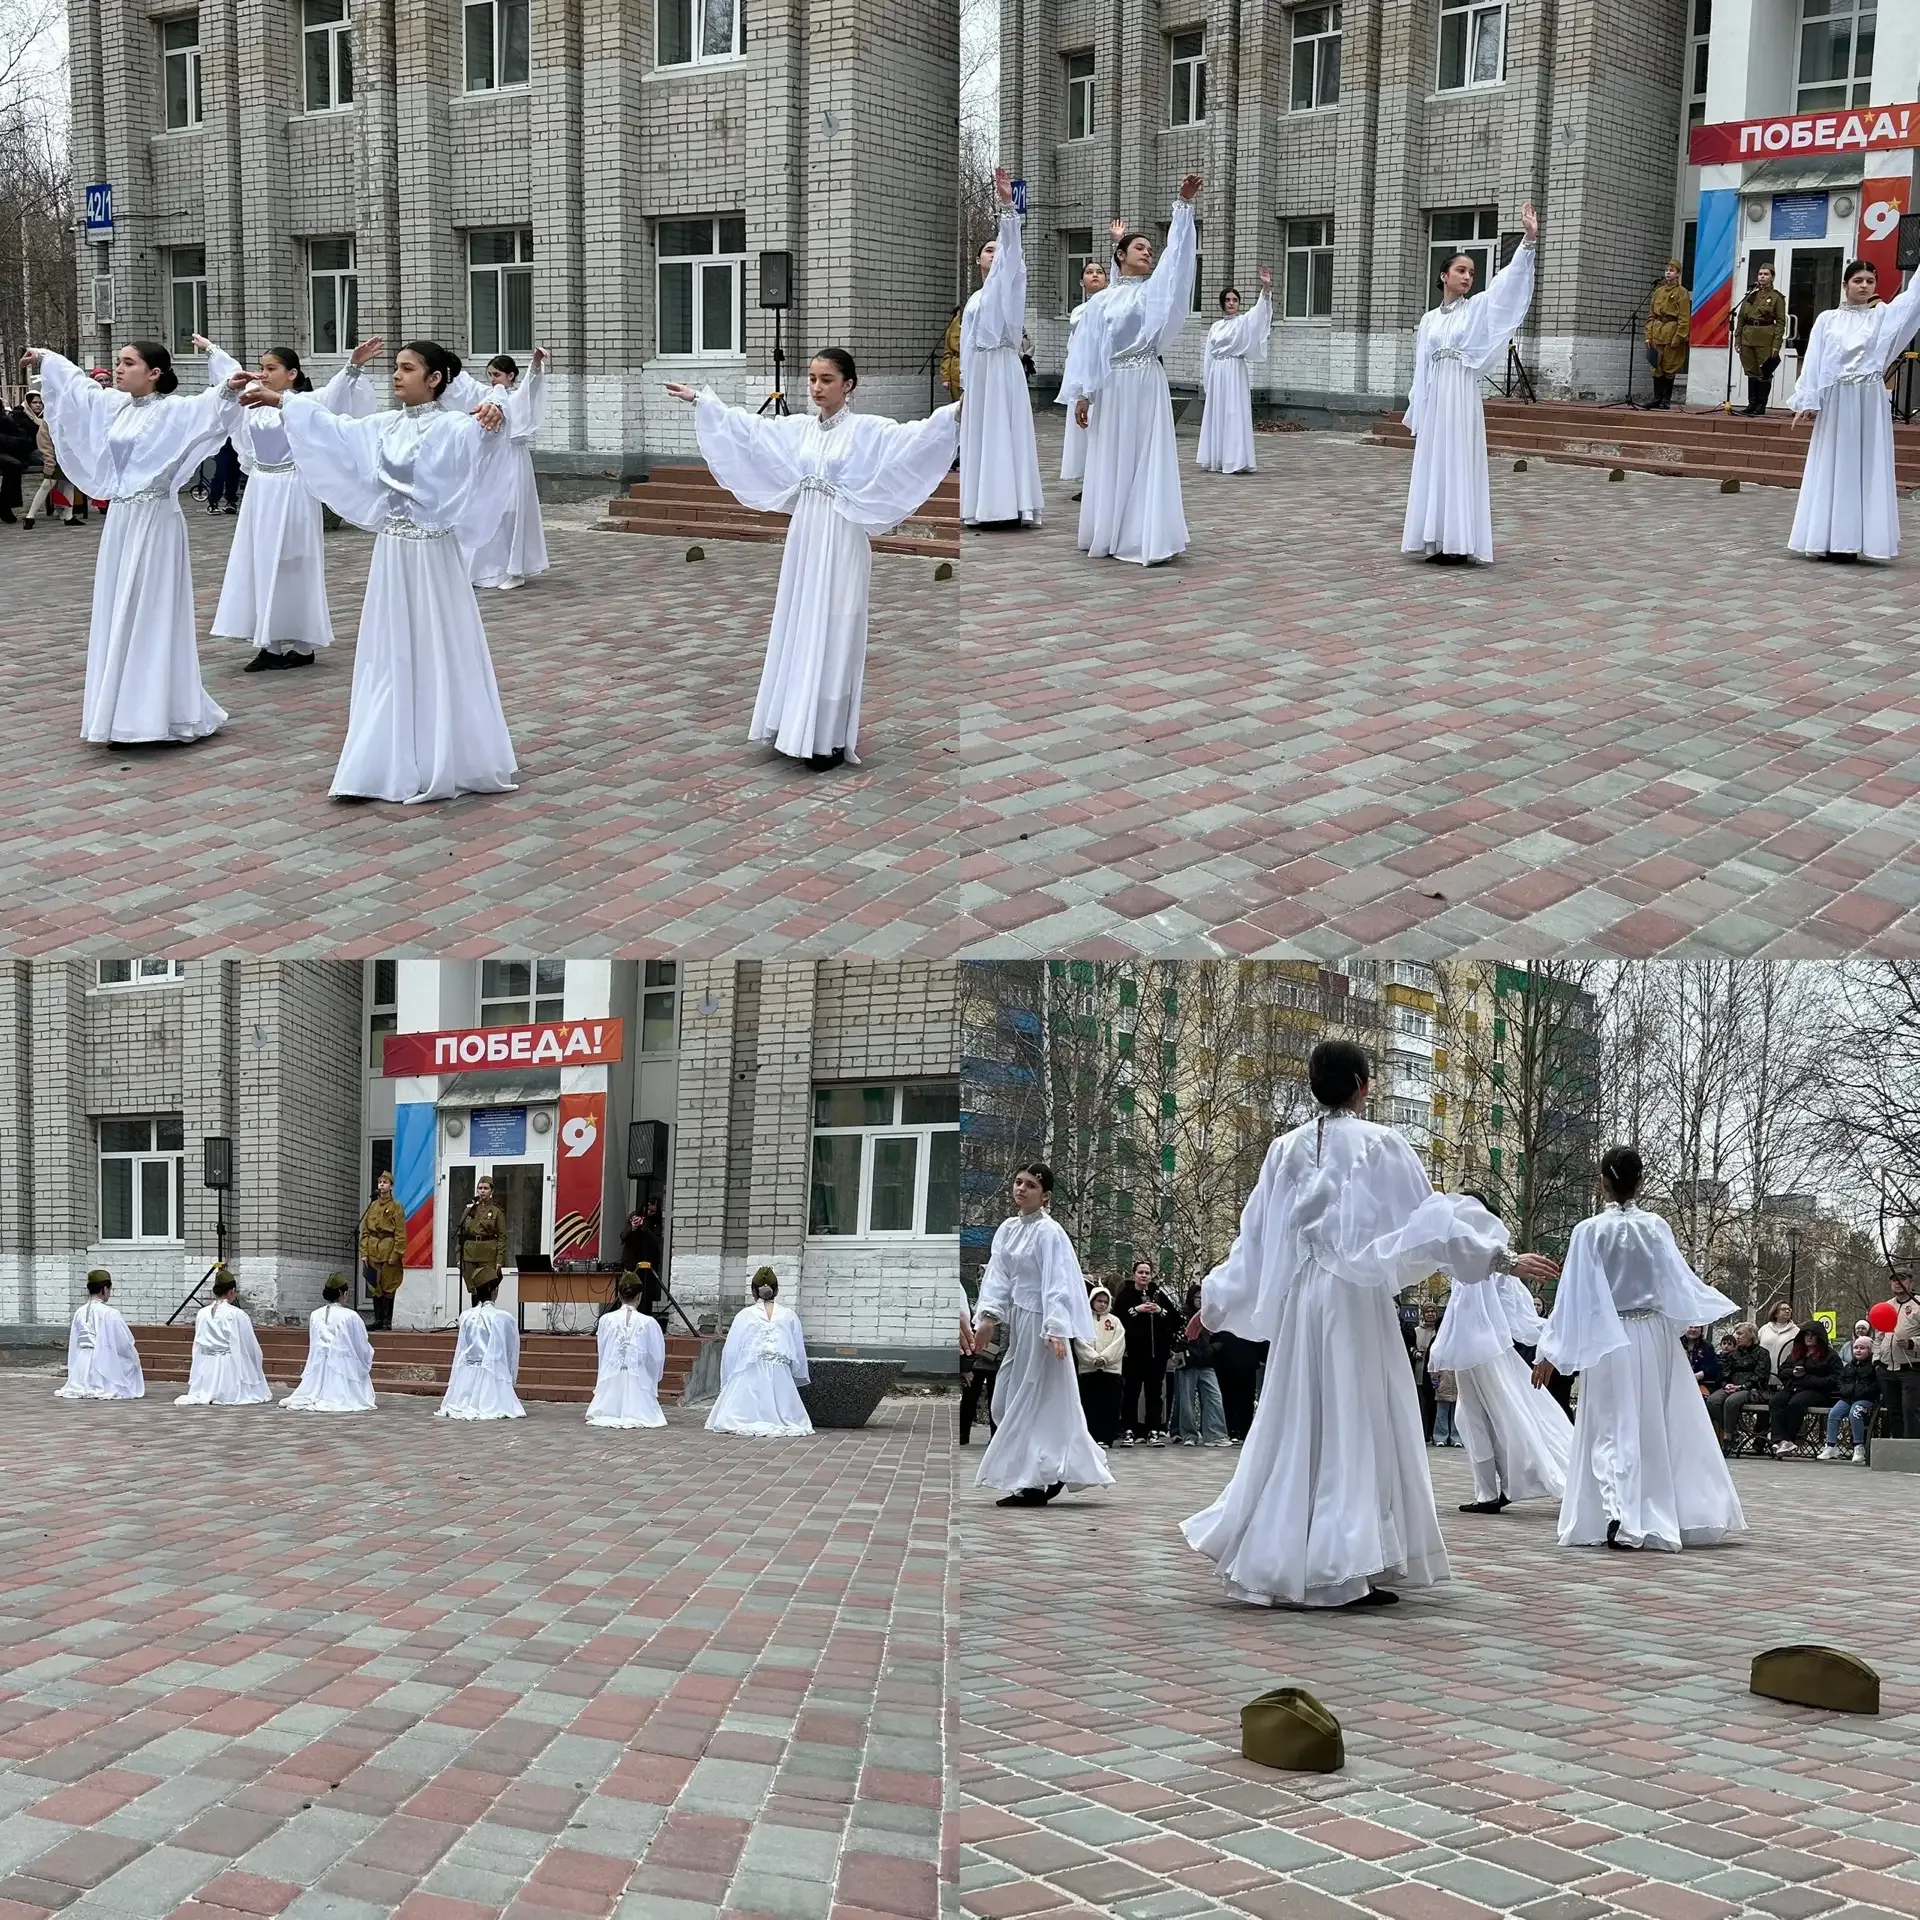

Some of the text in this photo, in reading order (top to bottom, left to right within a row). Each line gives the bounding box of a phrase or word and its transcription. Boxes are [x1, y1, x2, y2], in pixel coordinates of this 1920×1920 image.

[1739, 110, 1911, 153] ПОБЕДА!
[87, 190, 112, 222] 42/1
[1012, 185, 1026, 209] 2/1
[1863, 201, 1901, 241] 9
[435, 1025, 603, 1065] ПОБЕДА!
[561, 1117, 597, 1158] 9
